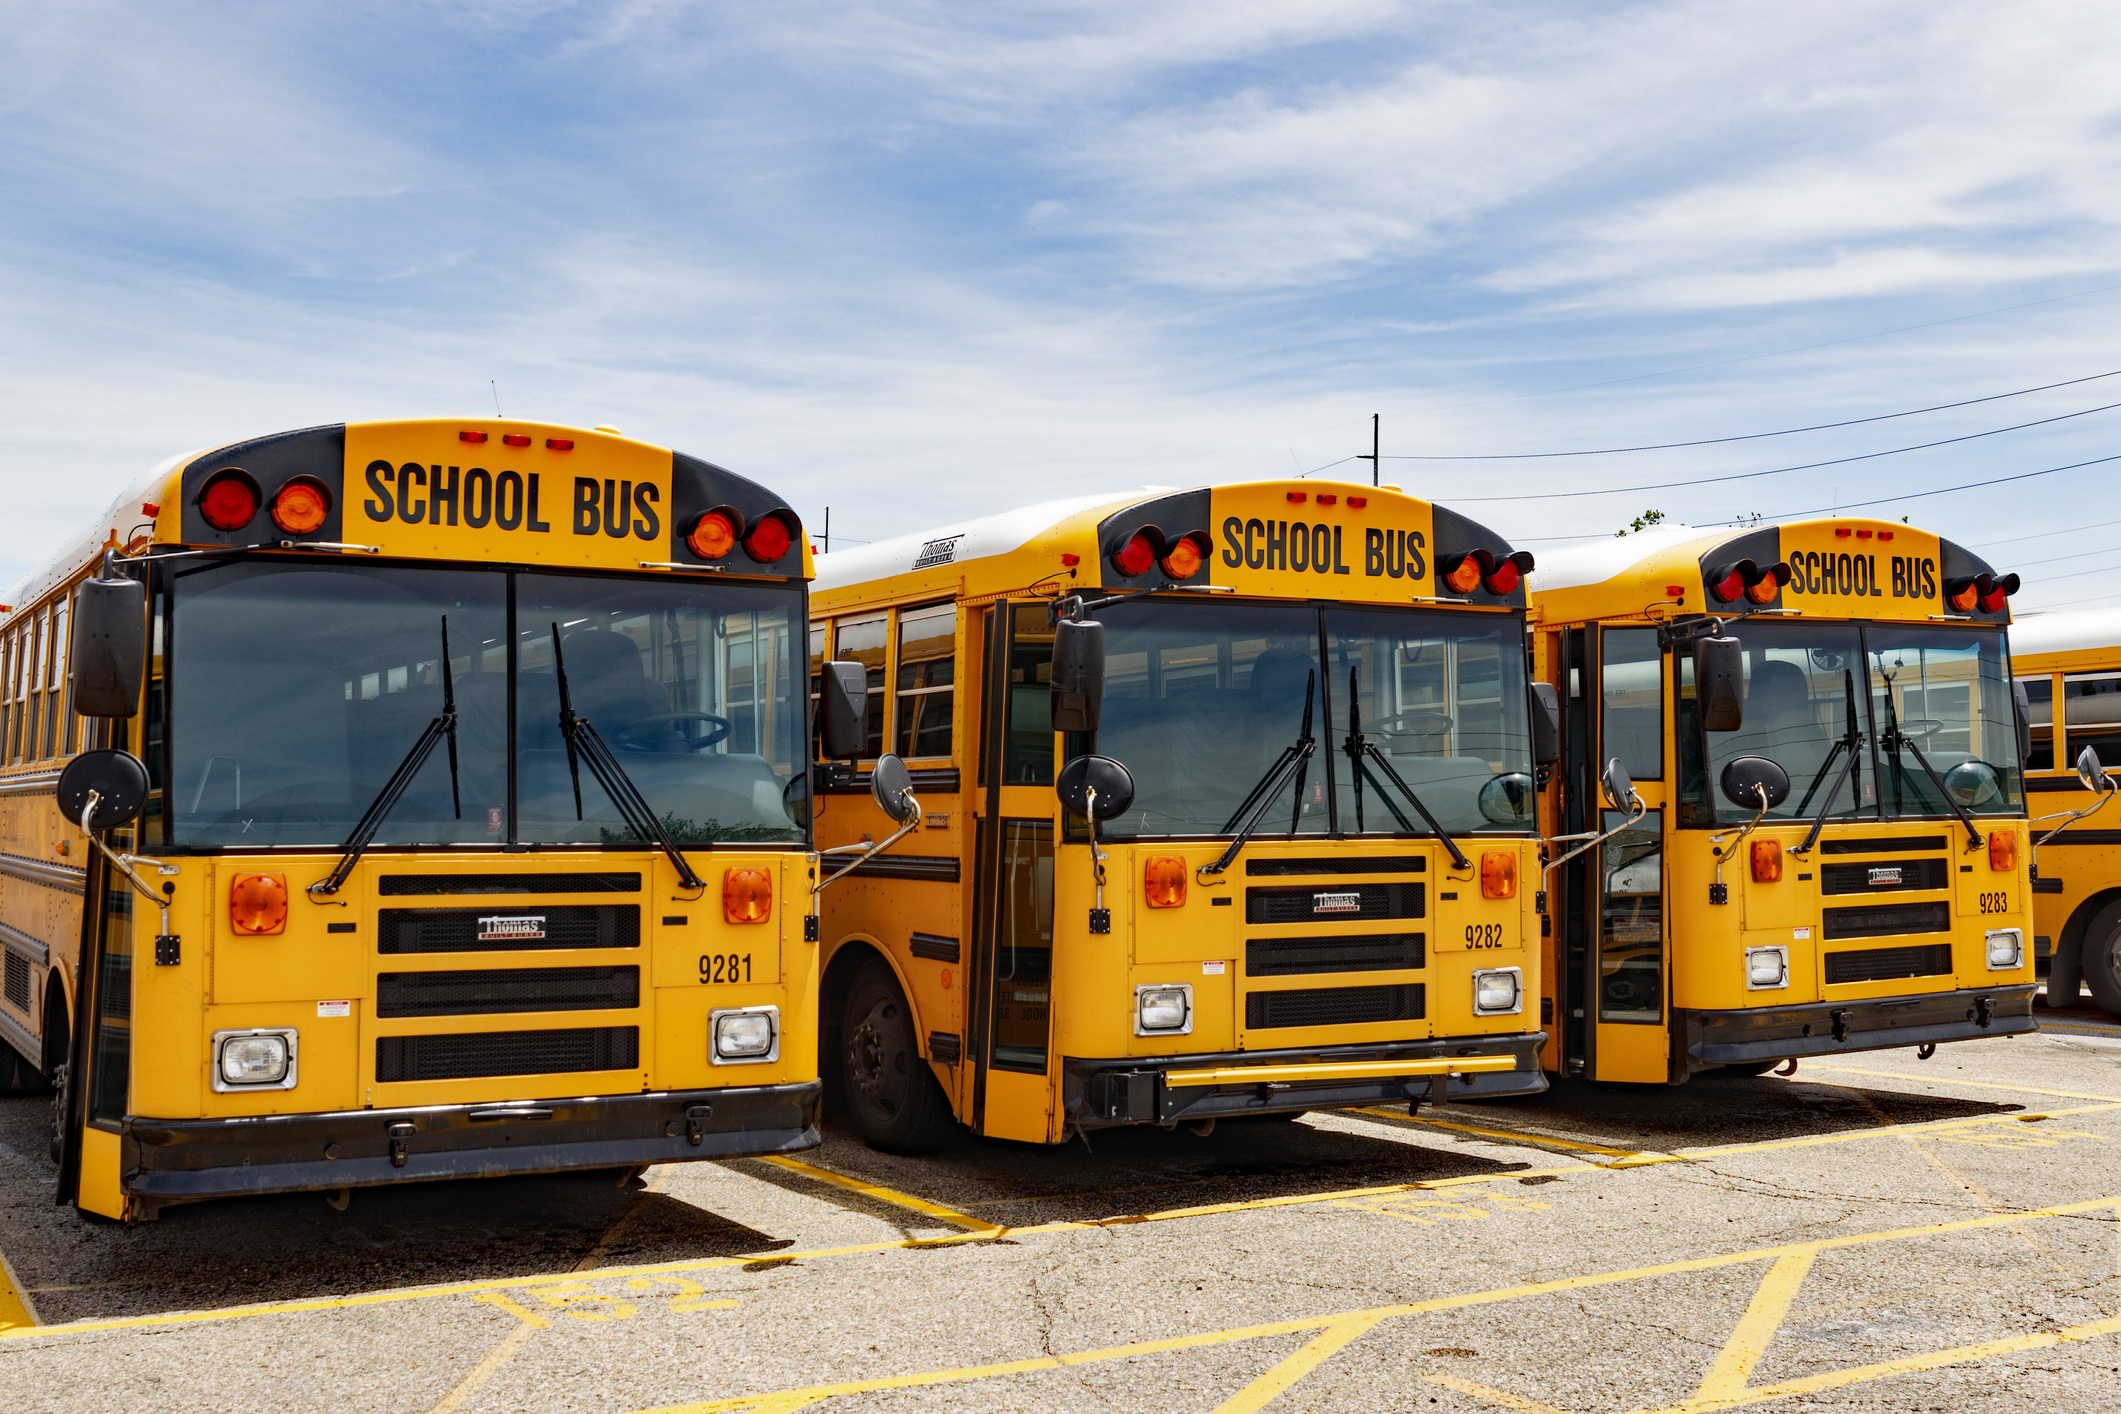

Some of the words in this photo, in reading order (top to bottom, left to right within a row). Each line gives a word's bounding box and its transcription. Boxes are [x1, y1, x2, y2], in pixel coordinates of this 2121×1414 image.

[364, 459, 550, 534] SCHOOL
[573, 476, 661, 541] BUS
[919, 533, 966, 559] Thomas
[1222, 516, 1350, 575] SCHOOL
[1365, 527, 1426, 581] BUS
[1789, 550, 1882, 597] SCHOOL
[1891, 556, 1936, 600] BUS
[1868, 867, 1902, 880] Thomas
[1313, 892, 1360, 907] Thomas
[1979, 891, 2008, 914] 9283
[478, 915, 546, 933] Thomas
[1465, 923, 1503, 950] 9282
[698, 953, 751, 985] 9281
[1910, 1124, 2110, 1151] 154
[1327, 1187, 1553, 1225] 153
[470, 1276, 745, 1330] 152
